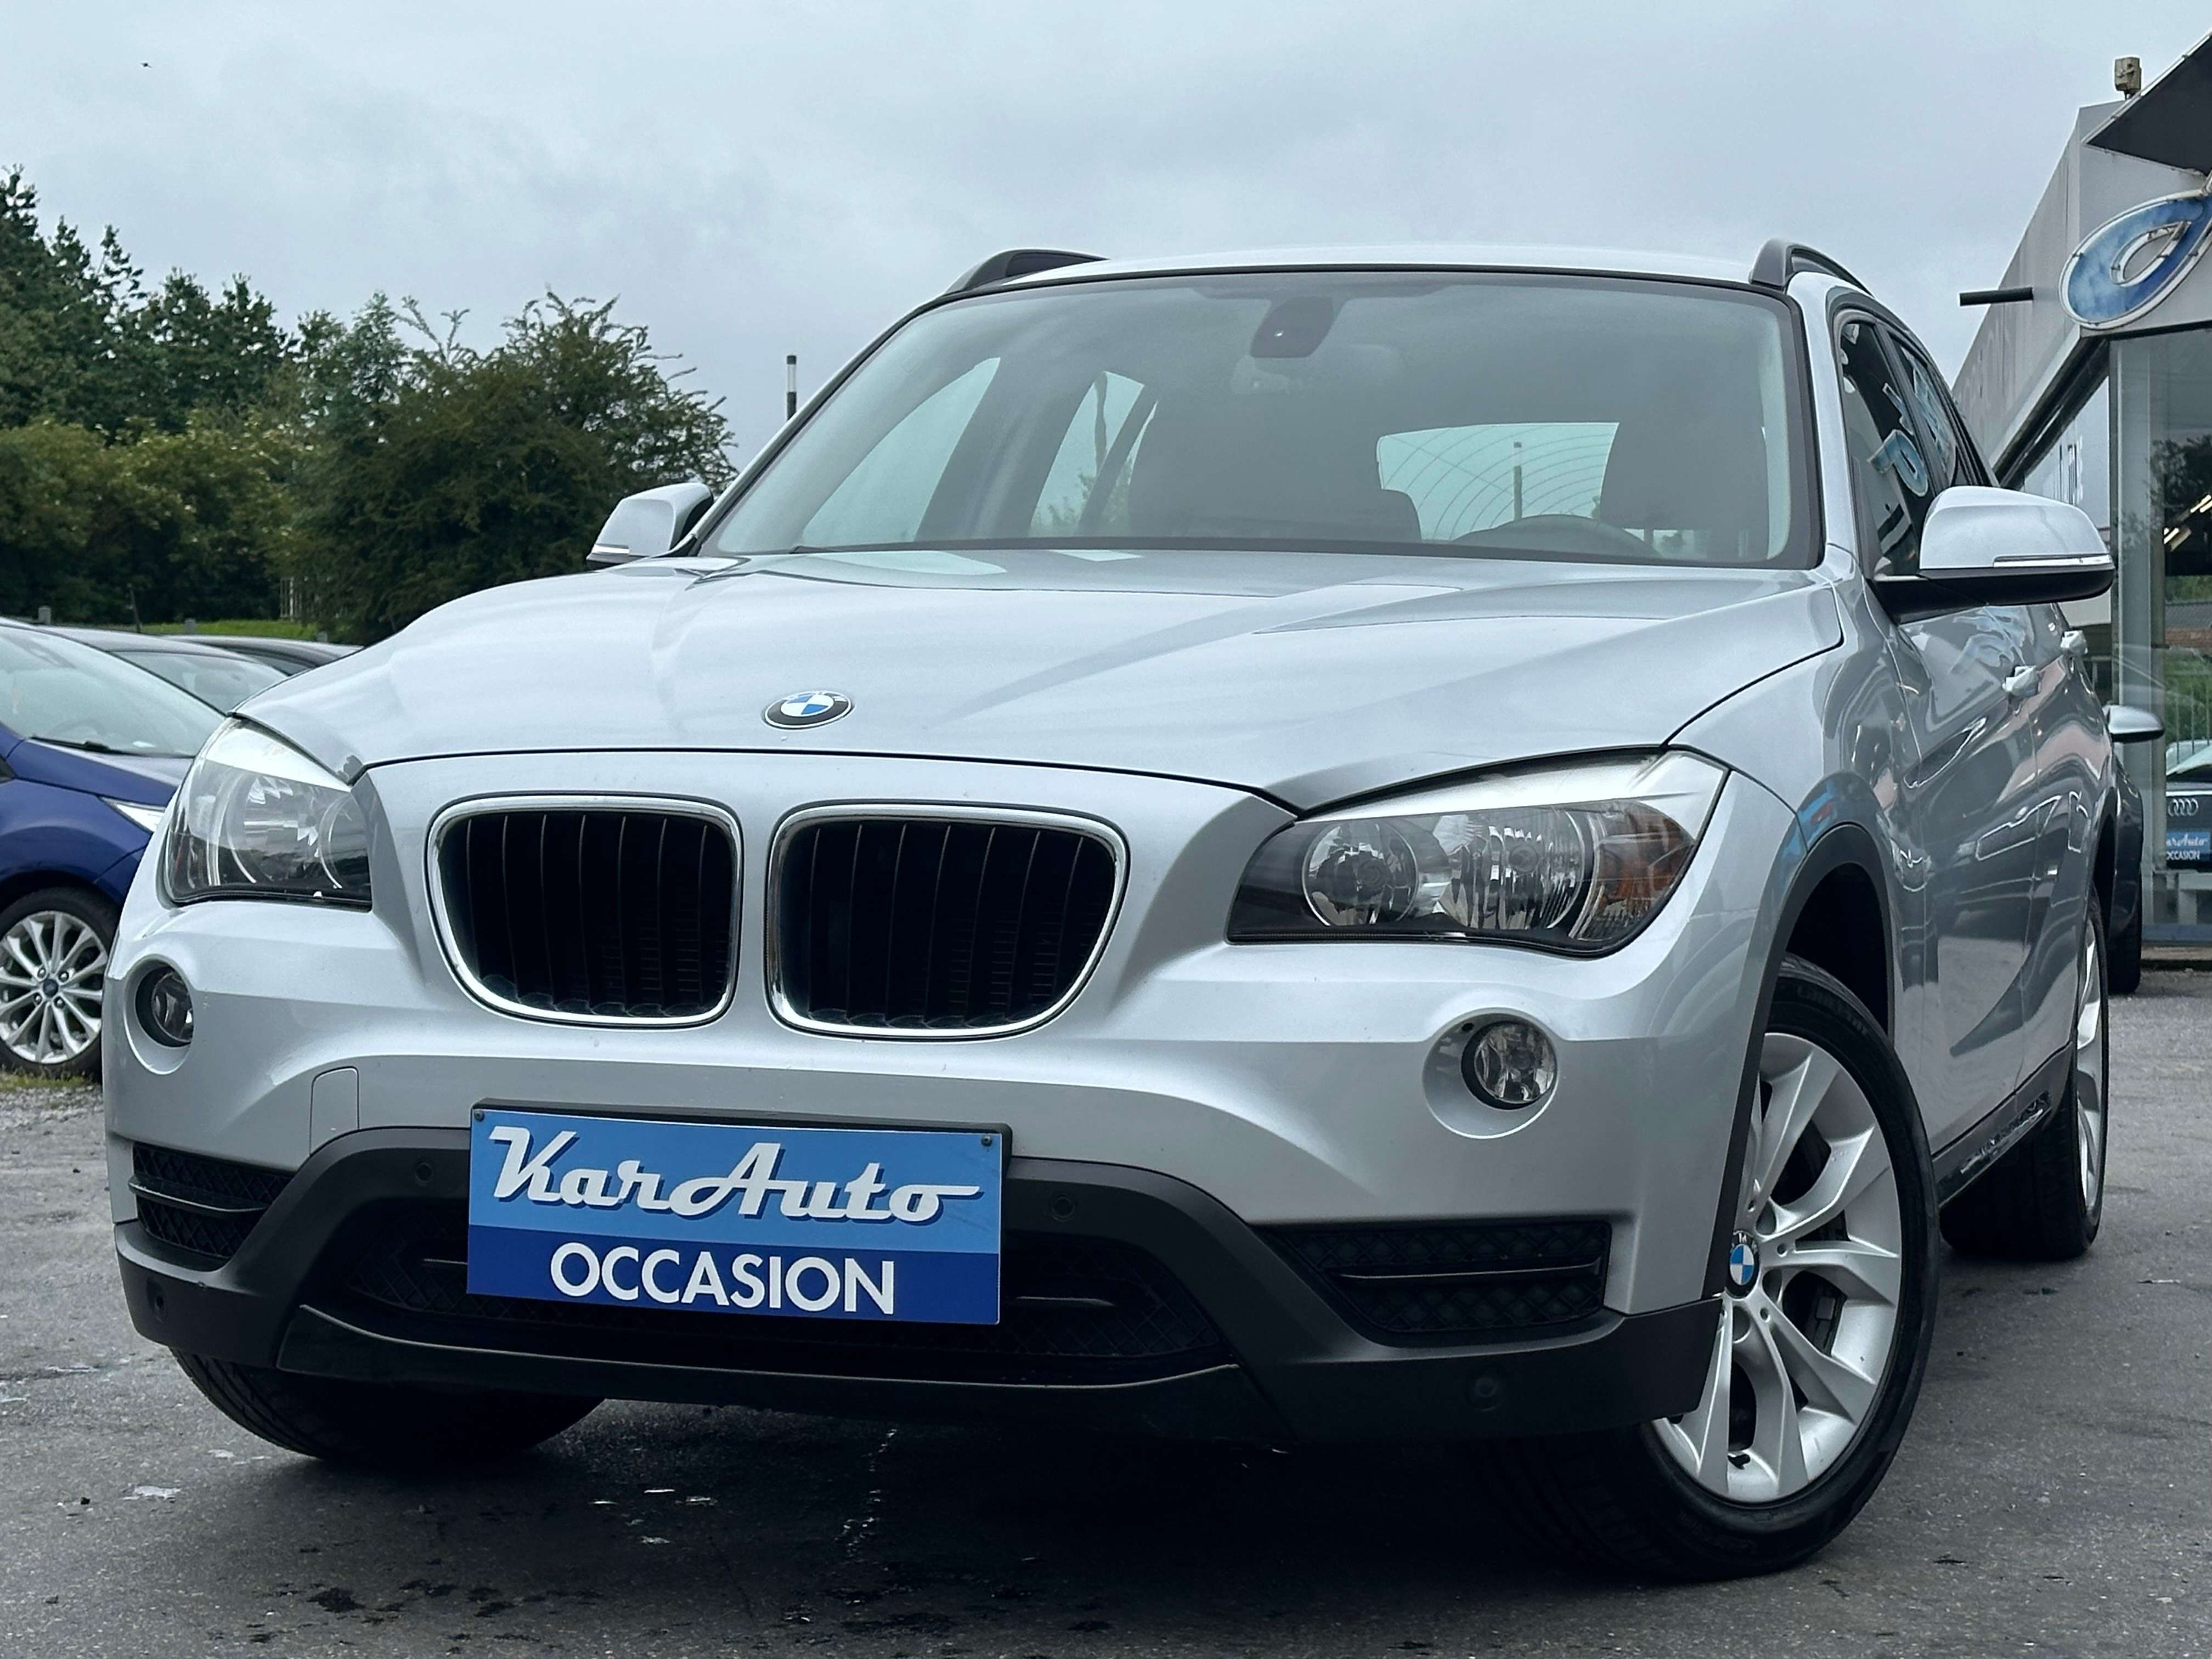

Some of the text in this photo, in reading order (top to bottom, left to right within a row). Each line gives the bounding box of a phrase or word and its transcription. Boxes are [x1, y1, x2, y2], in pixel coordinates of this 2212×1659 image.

[2166, 833, 2208, 847] arAuto
[488, 1125, 981, 1223] KarAuto
[550, 1241, 895, 1316] OCCASION
